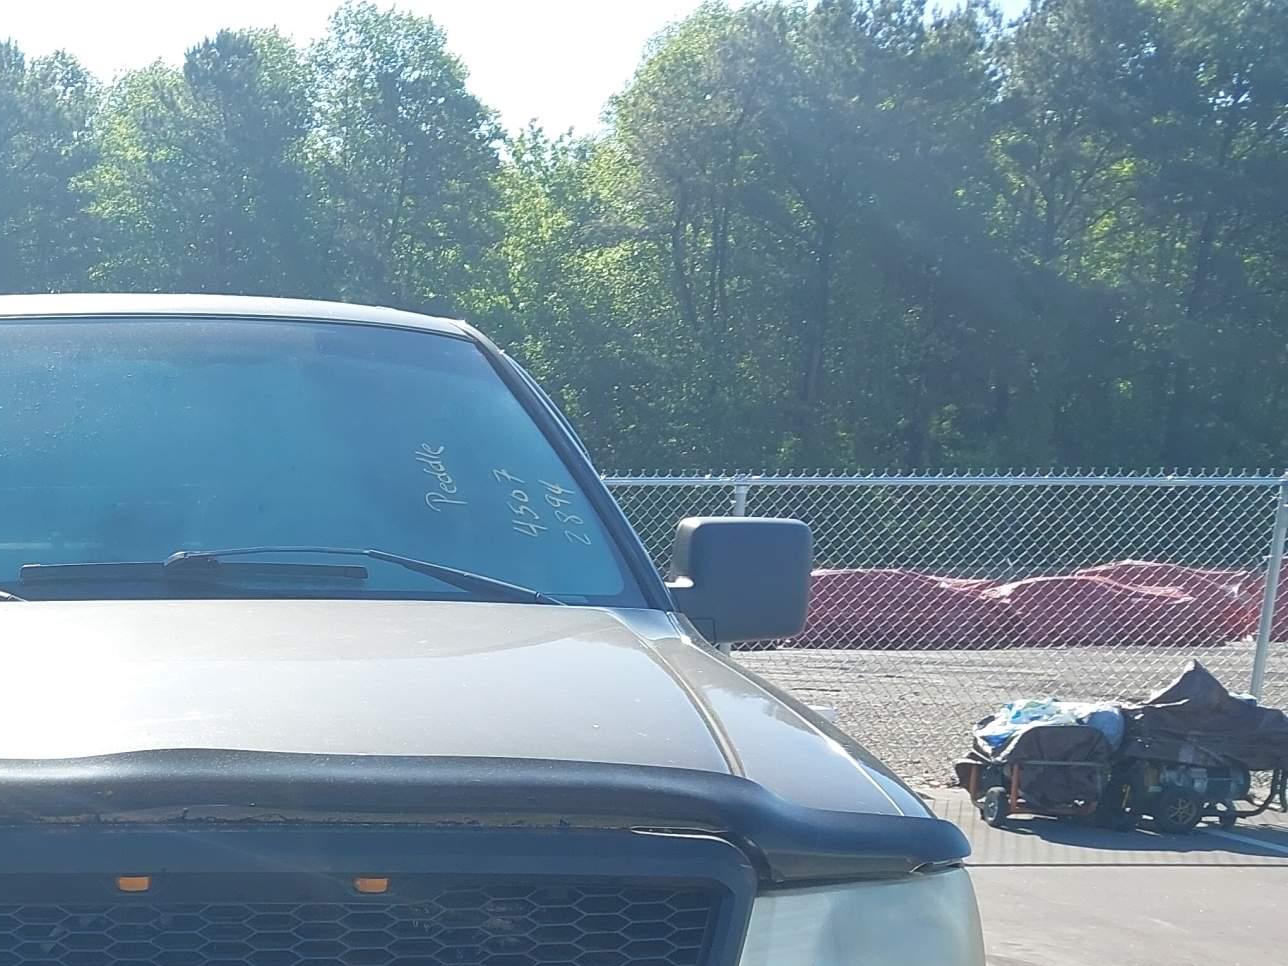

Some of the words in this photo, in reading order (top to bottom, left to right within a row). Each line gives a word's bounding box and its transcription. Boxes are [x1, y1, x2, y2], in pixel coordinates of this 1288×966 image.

[415, 442, 468, 512] Peddle
[491, 467, 549, 537] 4507
[537, 479, 592, 545] 2894
